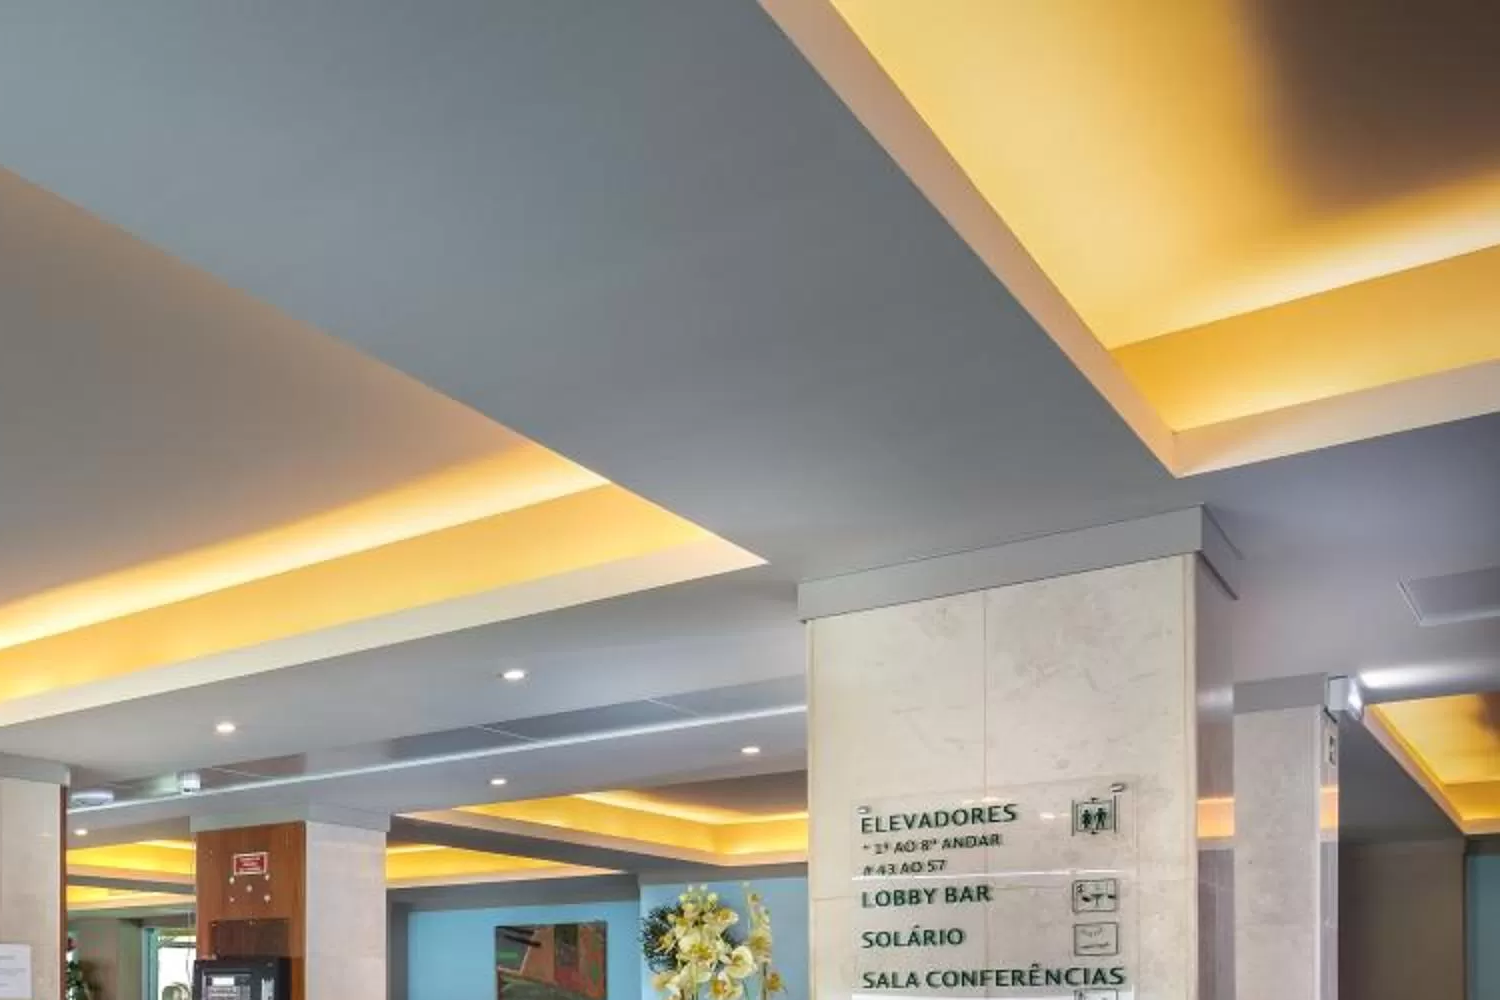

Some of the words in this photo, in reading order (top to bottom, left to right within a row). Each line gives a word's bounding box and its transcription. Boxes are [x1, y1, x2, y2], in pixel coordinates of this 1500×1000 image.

[861, 803, 1019, 834] ELEVADORES
[894, 839, 916, 854] AO
[942, 833, 1003, 850] ANDAR
[900, 861, 923, 874] AO
[927, 860, 948, 873] 57
[861, 888, 938, 909] LOBBY
[945, 885, 993, 904] BAR
[861, 924, 965, 949] SOLÁRIO
[862, 971, 921, 990] SALA
[925, 963, 1126, 989] CONFERÊNCIAS
